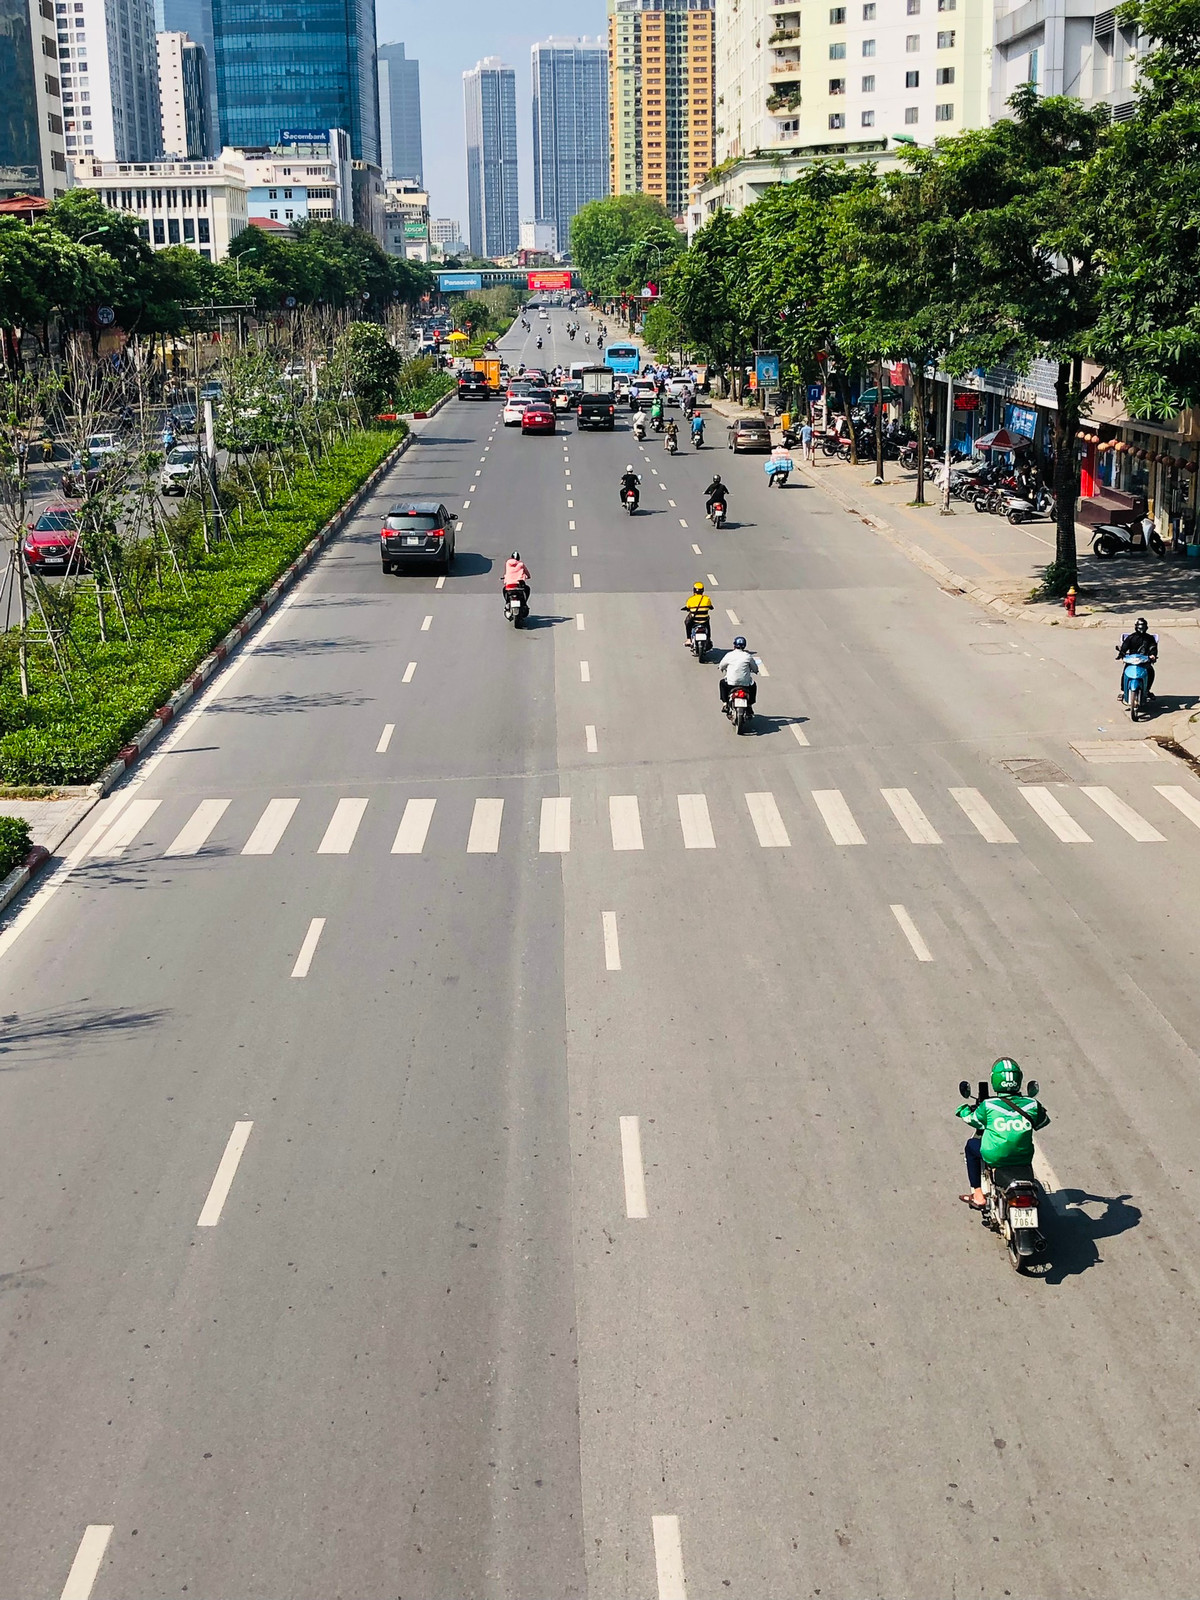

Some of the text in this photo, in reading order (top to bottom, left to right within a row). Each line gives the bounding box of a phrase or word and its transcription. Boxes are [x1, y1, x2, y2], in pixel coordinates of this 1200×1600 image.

[283, 131, 326, 140] Sacombank
[993, 1117, 1032, 1132] Grab
[1014, 1218, 1034, 1227] 7064
